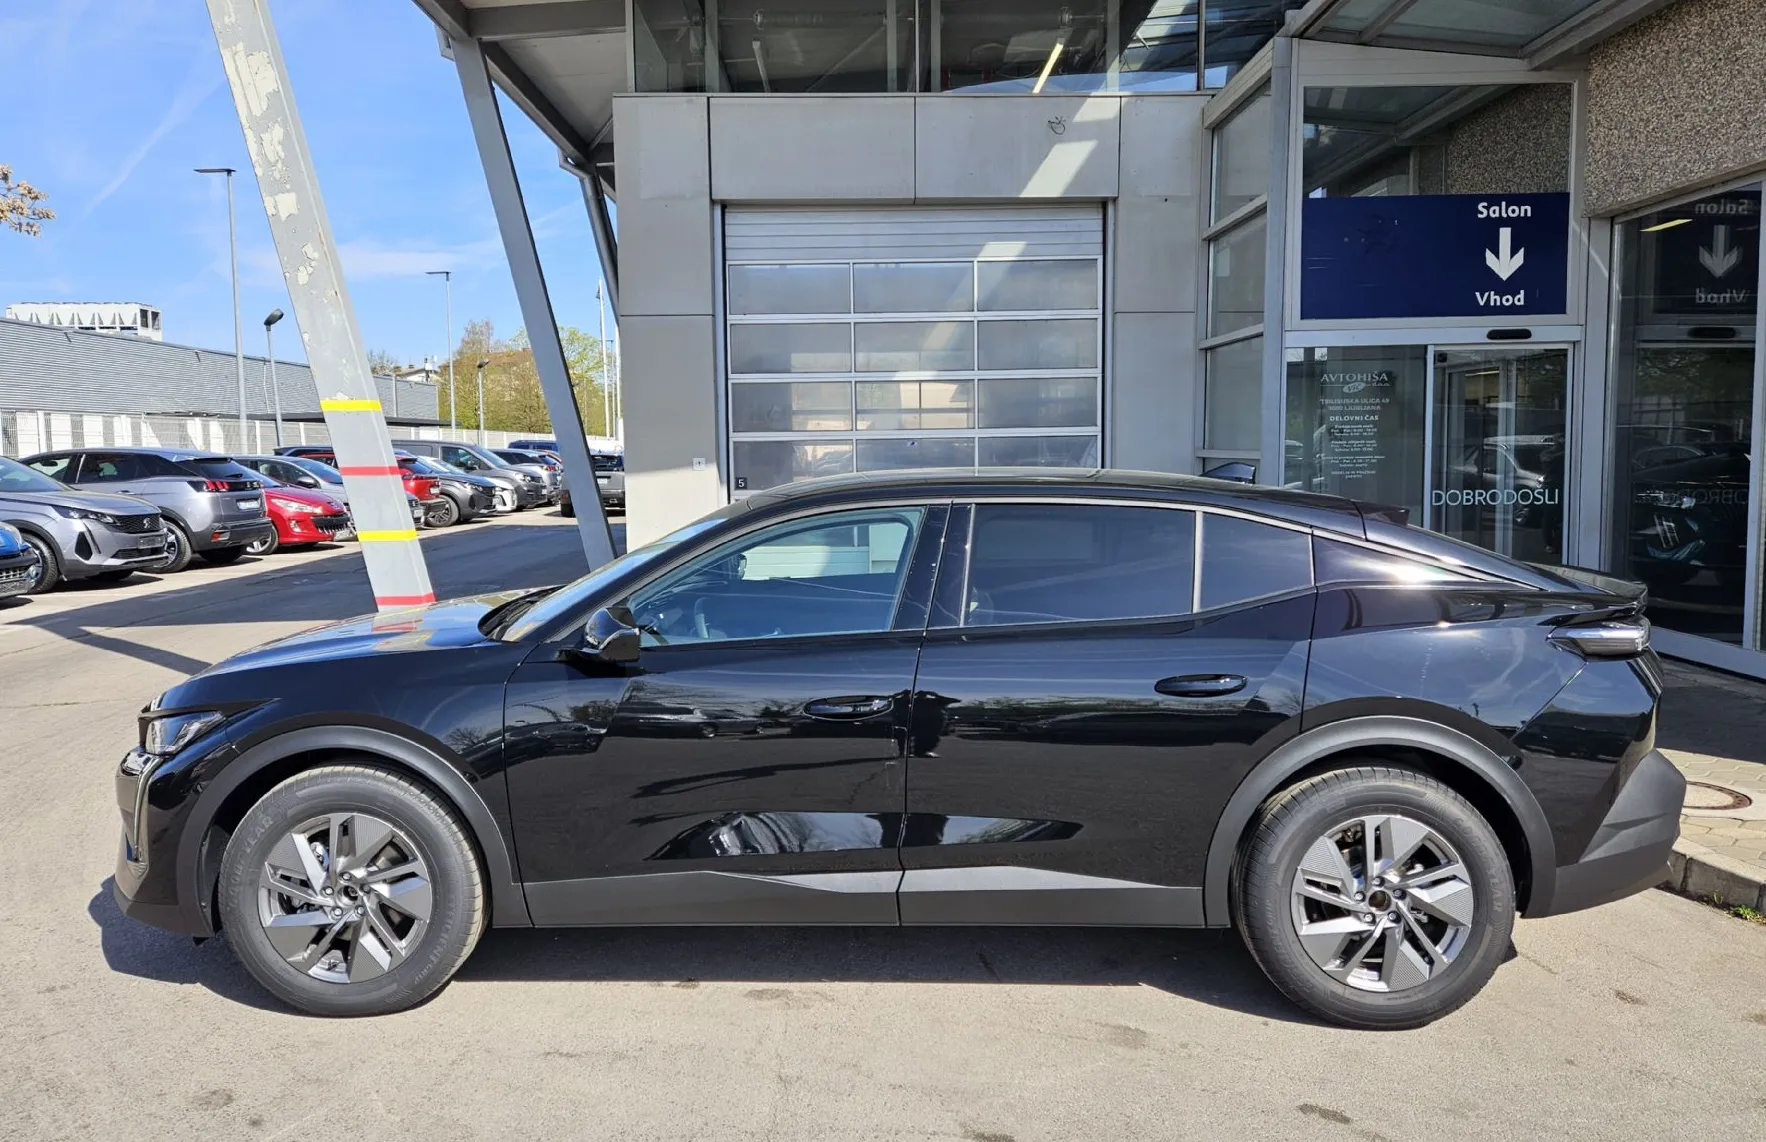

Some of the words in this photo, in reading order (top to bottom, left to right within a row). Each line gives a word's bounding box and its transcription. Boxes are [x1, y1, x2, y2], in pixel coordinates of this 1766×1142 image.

[1477, 201, 1531, 218] Salon
[1475, 289, 1525, 306] Vhod
[1320, 371, 1388, 382] AVTOHIŠA
[738, 478, 745, 488] 5
[1431, 484, 1559, 506] DOBRODOŠLI
